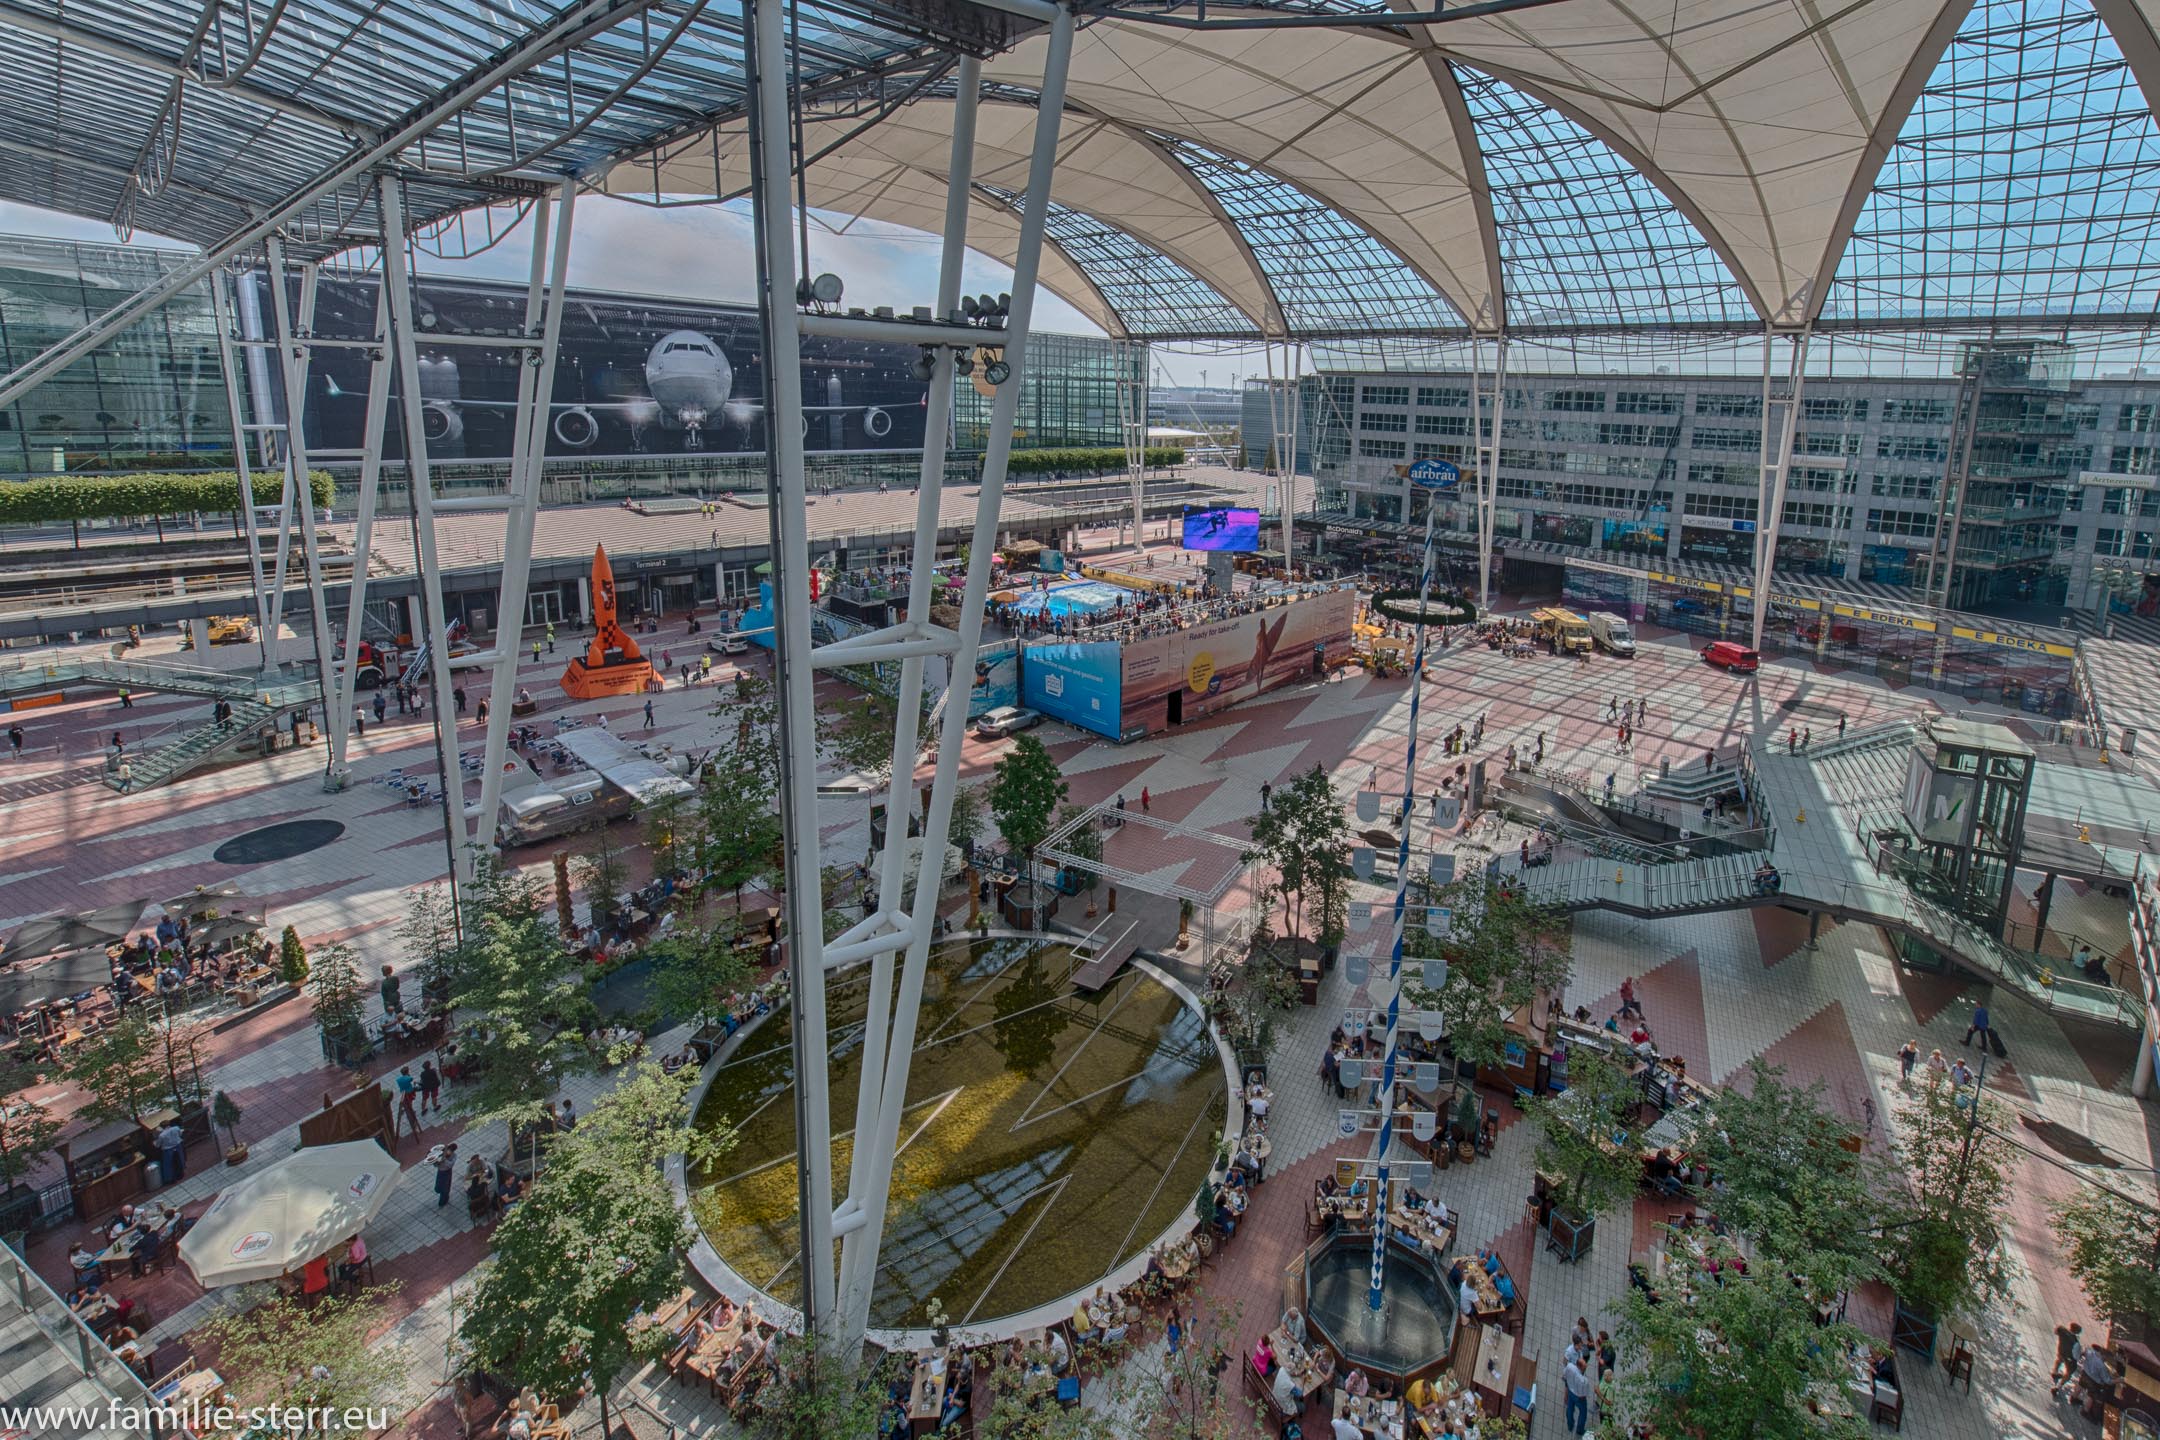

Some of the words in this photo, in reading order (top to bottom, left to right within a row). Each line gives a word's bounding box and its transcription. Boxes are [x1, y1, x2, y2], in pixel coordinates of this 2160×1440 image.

[1326, 525, 1363, 536] McDonald's
[2101, 557, 2131, 570] SCA
[1674, 577, 1706, 589] EDEKA
[1767, 594, 1801, 606] EDEKA
[1871, 612, 1914, 628] EDEKA
[1188, 631, 1208, 641] Ready
[1208, 628, 1217, 637] for
[1996, 634, 2048, 653] EDEKA
[1440, 806, 1454, 819] M
